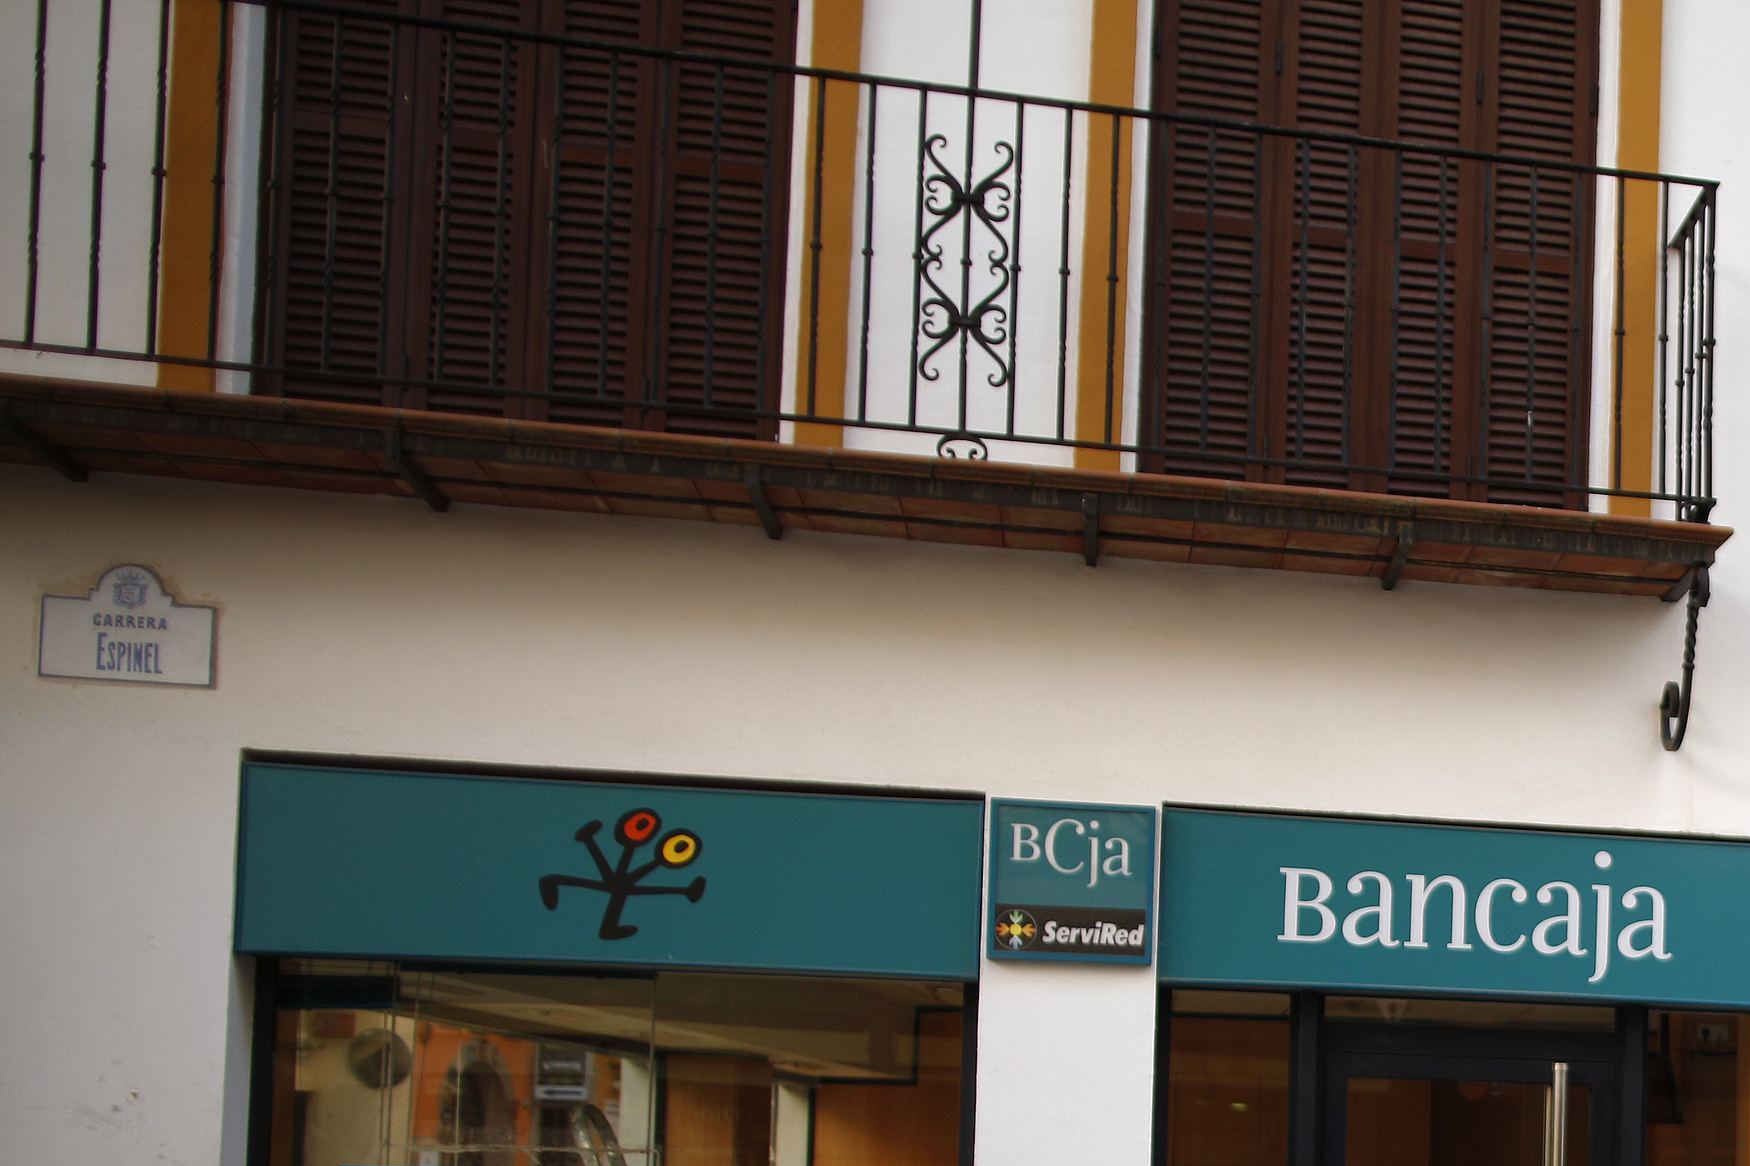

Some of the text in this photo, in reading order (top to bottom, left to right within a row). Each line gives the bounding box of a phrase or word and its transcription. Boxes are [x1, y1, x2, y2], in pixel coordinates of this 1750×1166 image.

[93, 613, 168, 630] CARRERA
[96, 631, 163, 674] ESPINEL
[1009, 818, 1132, 888] BCja
[1042, 920, 1145, 947] ServiRed
[1276, 850, 1674, 983] Bancaja
